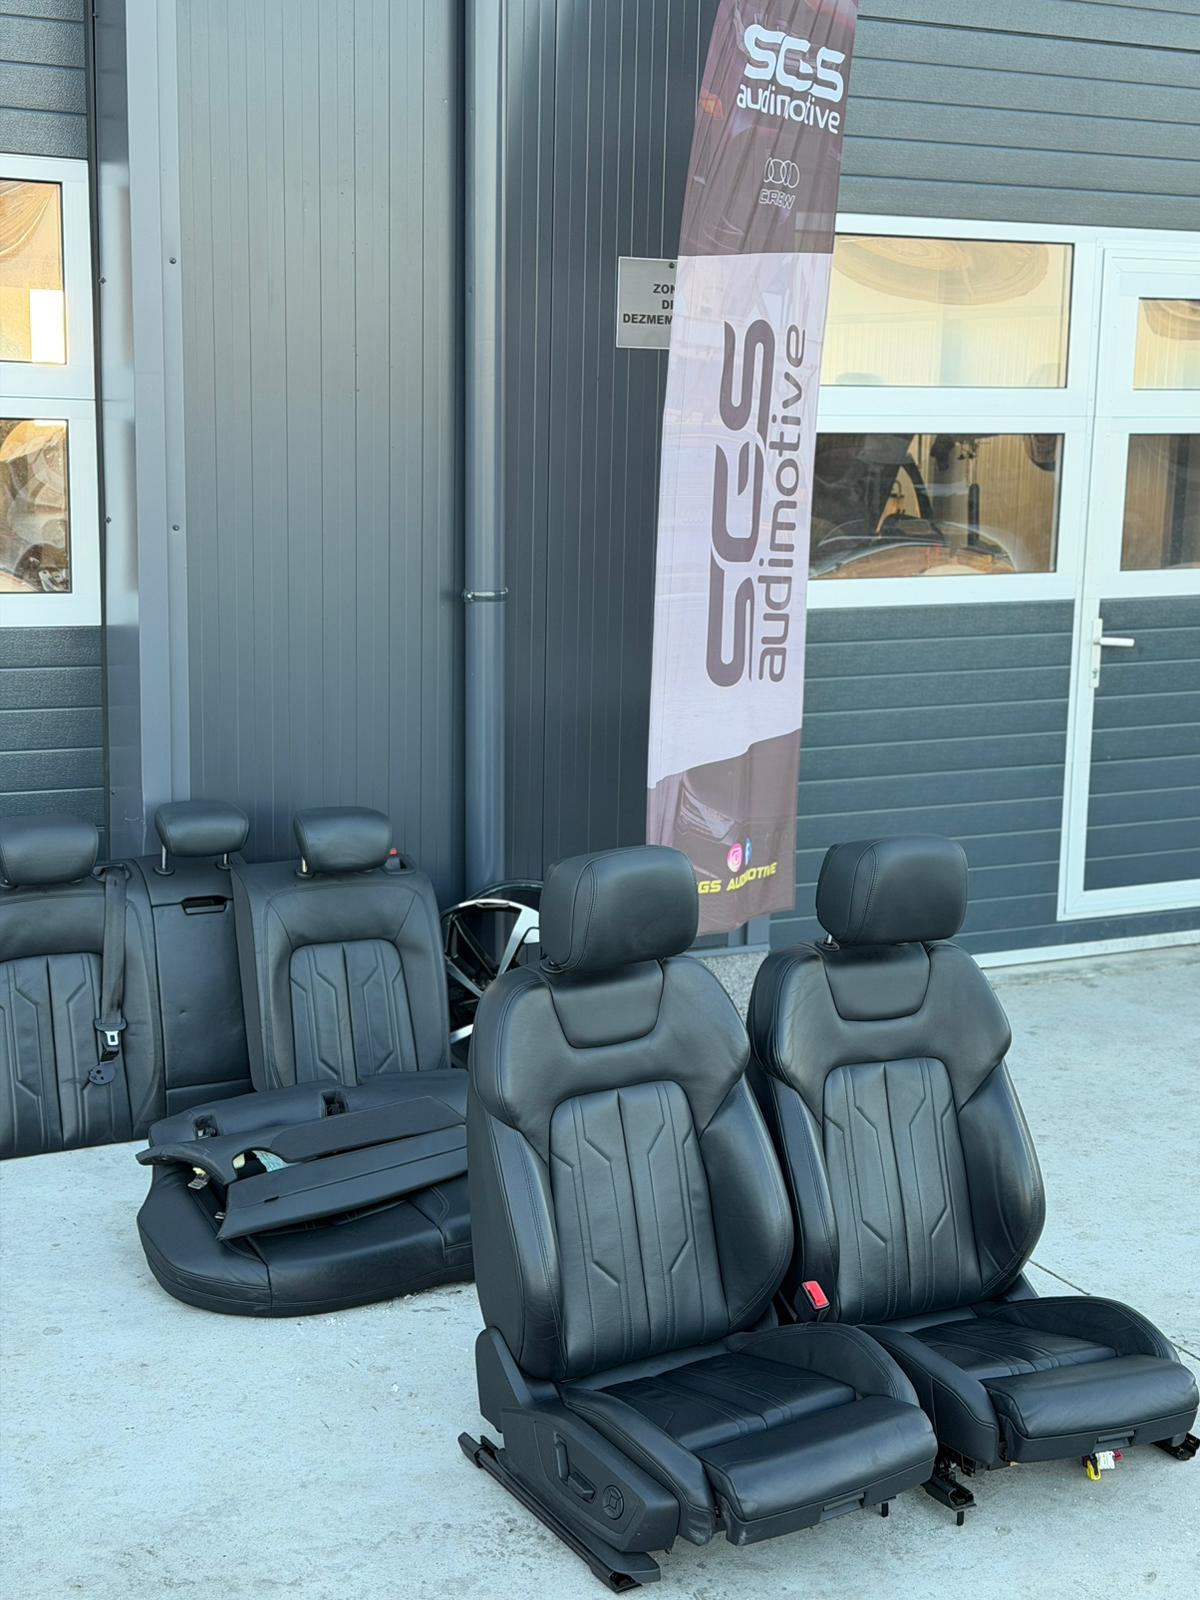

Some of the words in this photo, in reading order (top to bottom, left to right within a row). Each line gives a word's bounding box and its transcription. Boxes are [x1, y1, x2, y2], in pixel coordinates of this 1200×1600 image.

[743, 23, 846, 103] SGS
[705, 318, 776, 688] SGS
[757, 323, 807, 684] audimotive
[697, 879, 722, 894] GS
